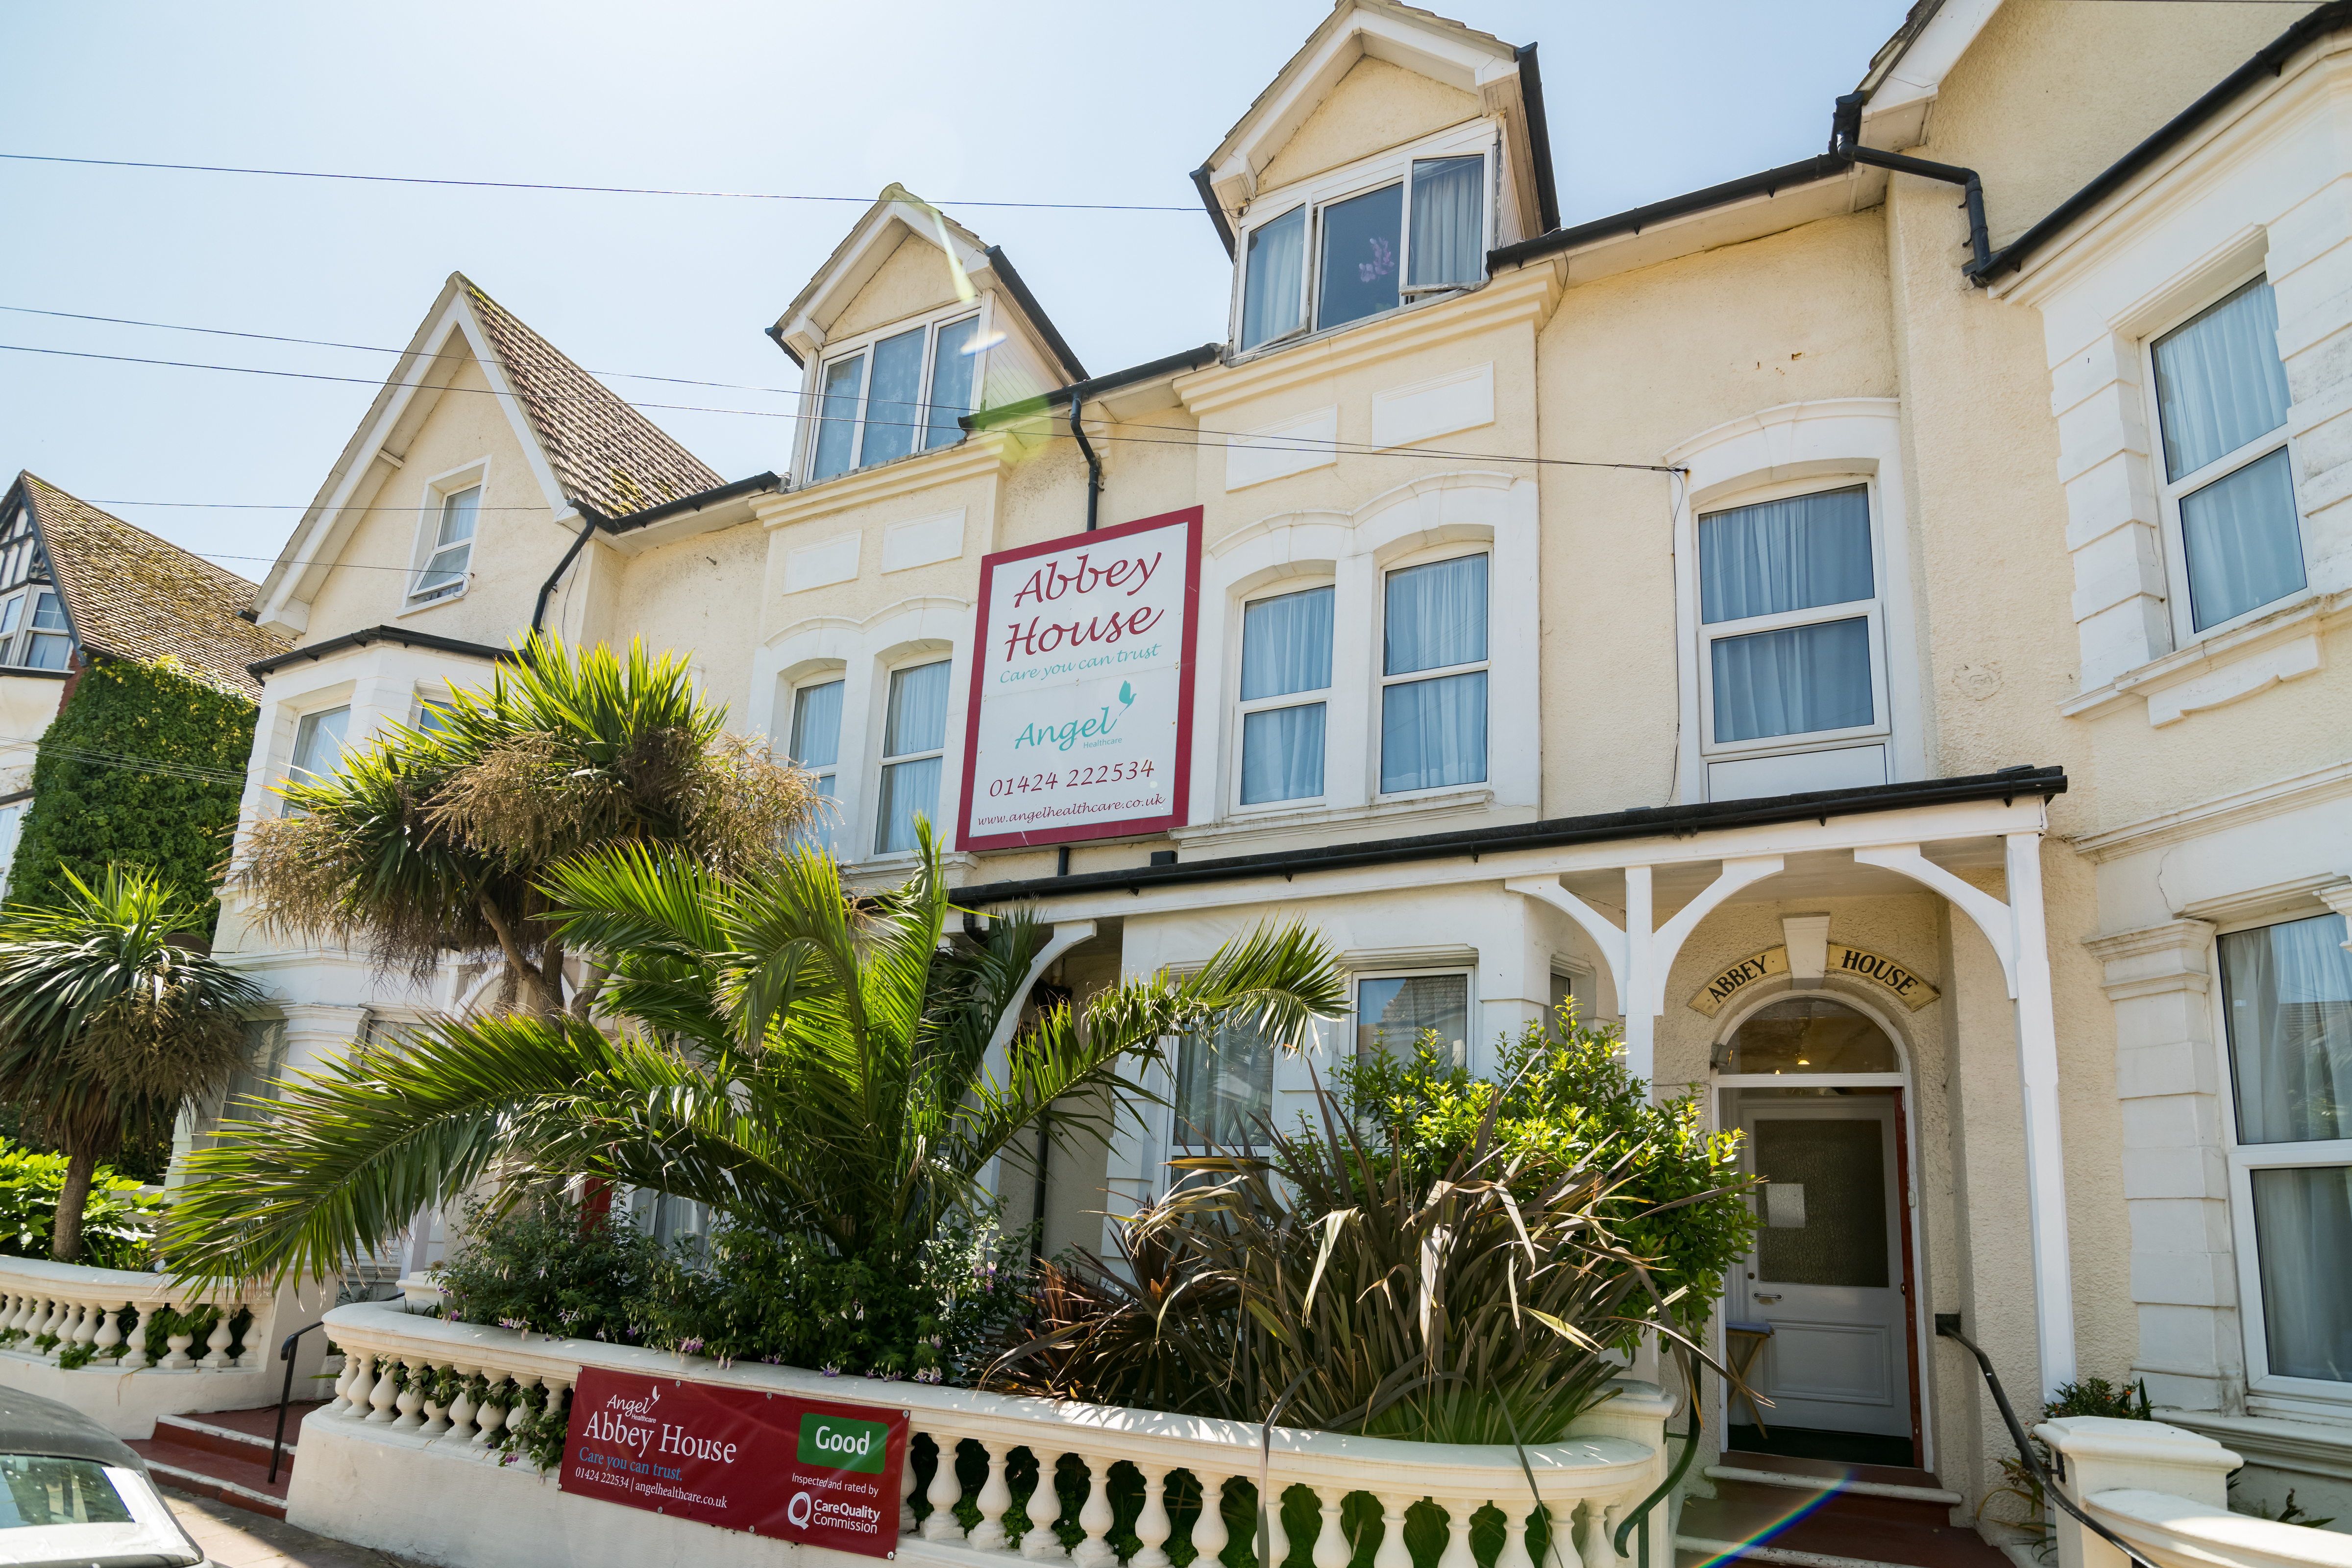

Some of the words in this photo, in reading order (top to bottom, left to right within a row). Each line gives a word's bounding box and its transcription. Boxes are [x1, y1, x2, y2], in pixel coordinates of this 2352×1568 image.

[1013, 552, 1162, 608] Abbey
[1004, 606, 1165, 662] House
[1000, 669, 1041, 683] Care
[1041, 662, 1076, 680] you
[1078, 656, 1114, 669] can
[1117, 643, 1162, 663] trust
[1015, 706, 1117, 751] Angel
[1083, 737, 1122, 748] Healthcare
[989, 772, 1058, 797] 01424
[1066, 759, 1154, 787] 222534
[978, 793, 1166, 825] www.angelhealthcare.co.uk
[1707, 955, 1766, 1004] ABBEY
[1841, 950, 1918, 996] HOUSE
[607, 1394, 651, 1417] Angel
[631, 1413, 657, 1423] Healthcare
[583, 1411, 655, 1458] Abbey
[659, 1423, 736, 1464] House
[815, 1425, 870, 1455] Good
[579, 1447, 604, 1464] Care
[606, 1456, 627, 1470] you
[630, 1461, 649, 1474] can
[653, 1463, 682, 1481] trust.
[575, 1467, 599, 1481] 01424
[601, 1472, 629, 1488] 222534
[635, 1482, 727, 1509] angelhealthcare.co.uk
[792, 1472, 829, 1487] Inspected
[828, 1480, 842, 1490] and
[844, 1483, 866, 1493] rated
[869, 1484, 879, 1497] by
[813, 1513, 877, 1534] Commission
